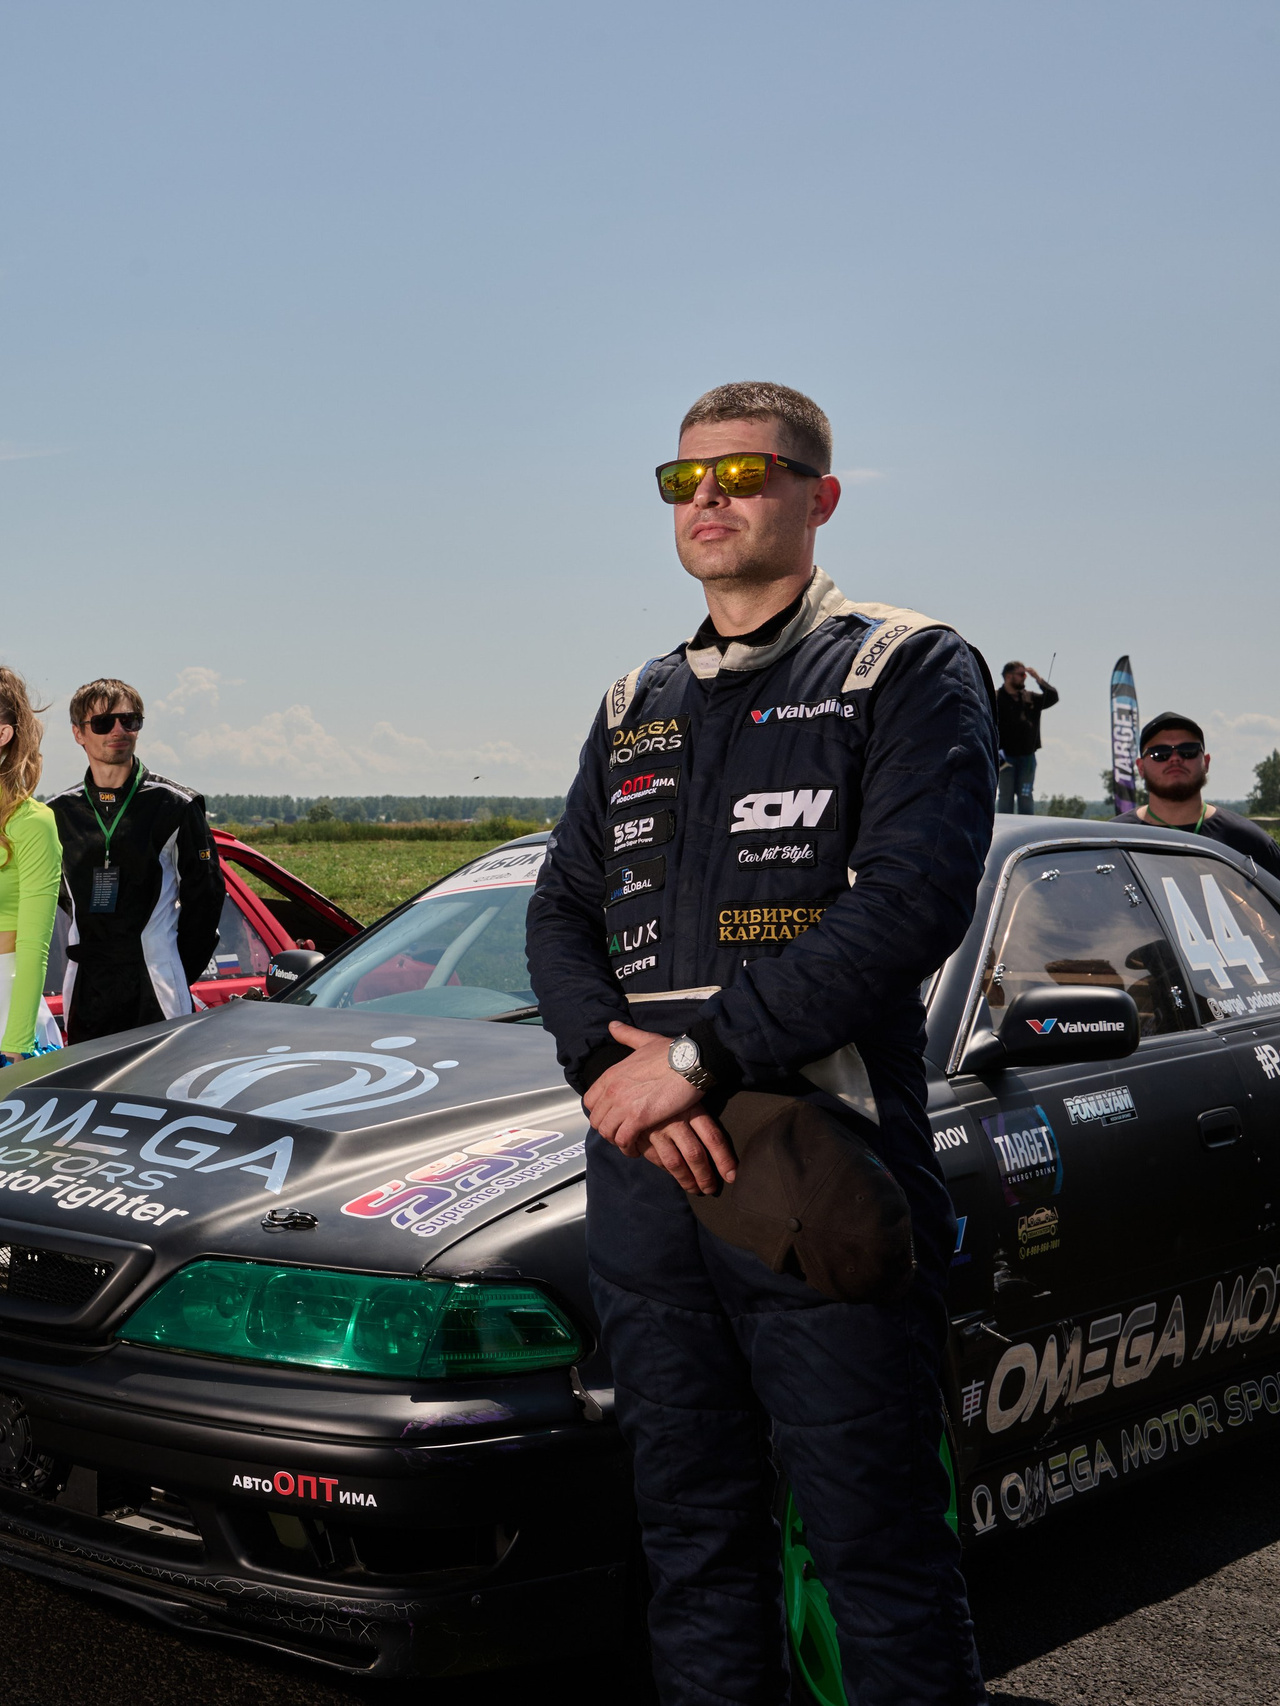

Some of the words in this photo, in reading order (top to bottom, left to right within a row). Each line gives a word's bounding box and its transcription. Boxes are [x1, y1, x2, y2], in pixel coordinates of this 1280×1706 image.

[855, 625, 912, 678] sparco
[776, 699, 854, 719] Valvoline
[1113, 697, 1134, 782] TARGET
[614, 817, 654, 845] SSP
[730, 789, 833, 833] SCW
[738, 849, 760, 863] Car
[782, 843, 814, 863] Style
[607, 919, 658, 954] ALUX
[719, 908, 826, 924] СИБИРСК
[1161, 874, 1270, 989] 44
[1058, 1020, 1125, 1033] Valvoline
[1254, 1044, 1280, 1079] #P
[993, 1126, 1054, 1172] TARGET
[340, 1128, 564, 1229] SSP
[414, 1186, 503, 1236] Supreme
[496, 1160, 551, 1189] Super
[546, 1141, 585, 1163] Pow
[1007, 1172, 1033, 1184] ENERGY
[1035, 1165, 1057, 1178] DRINK
[986, 1295, 1185, 1434] OMEGA
[1000, 1439, 1117, 1525] OMEGA
[1121, 1395, 1224, 1473] MOTOR
